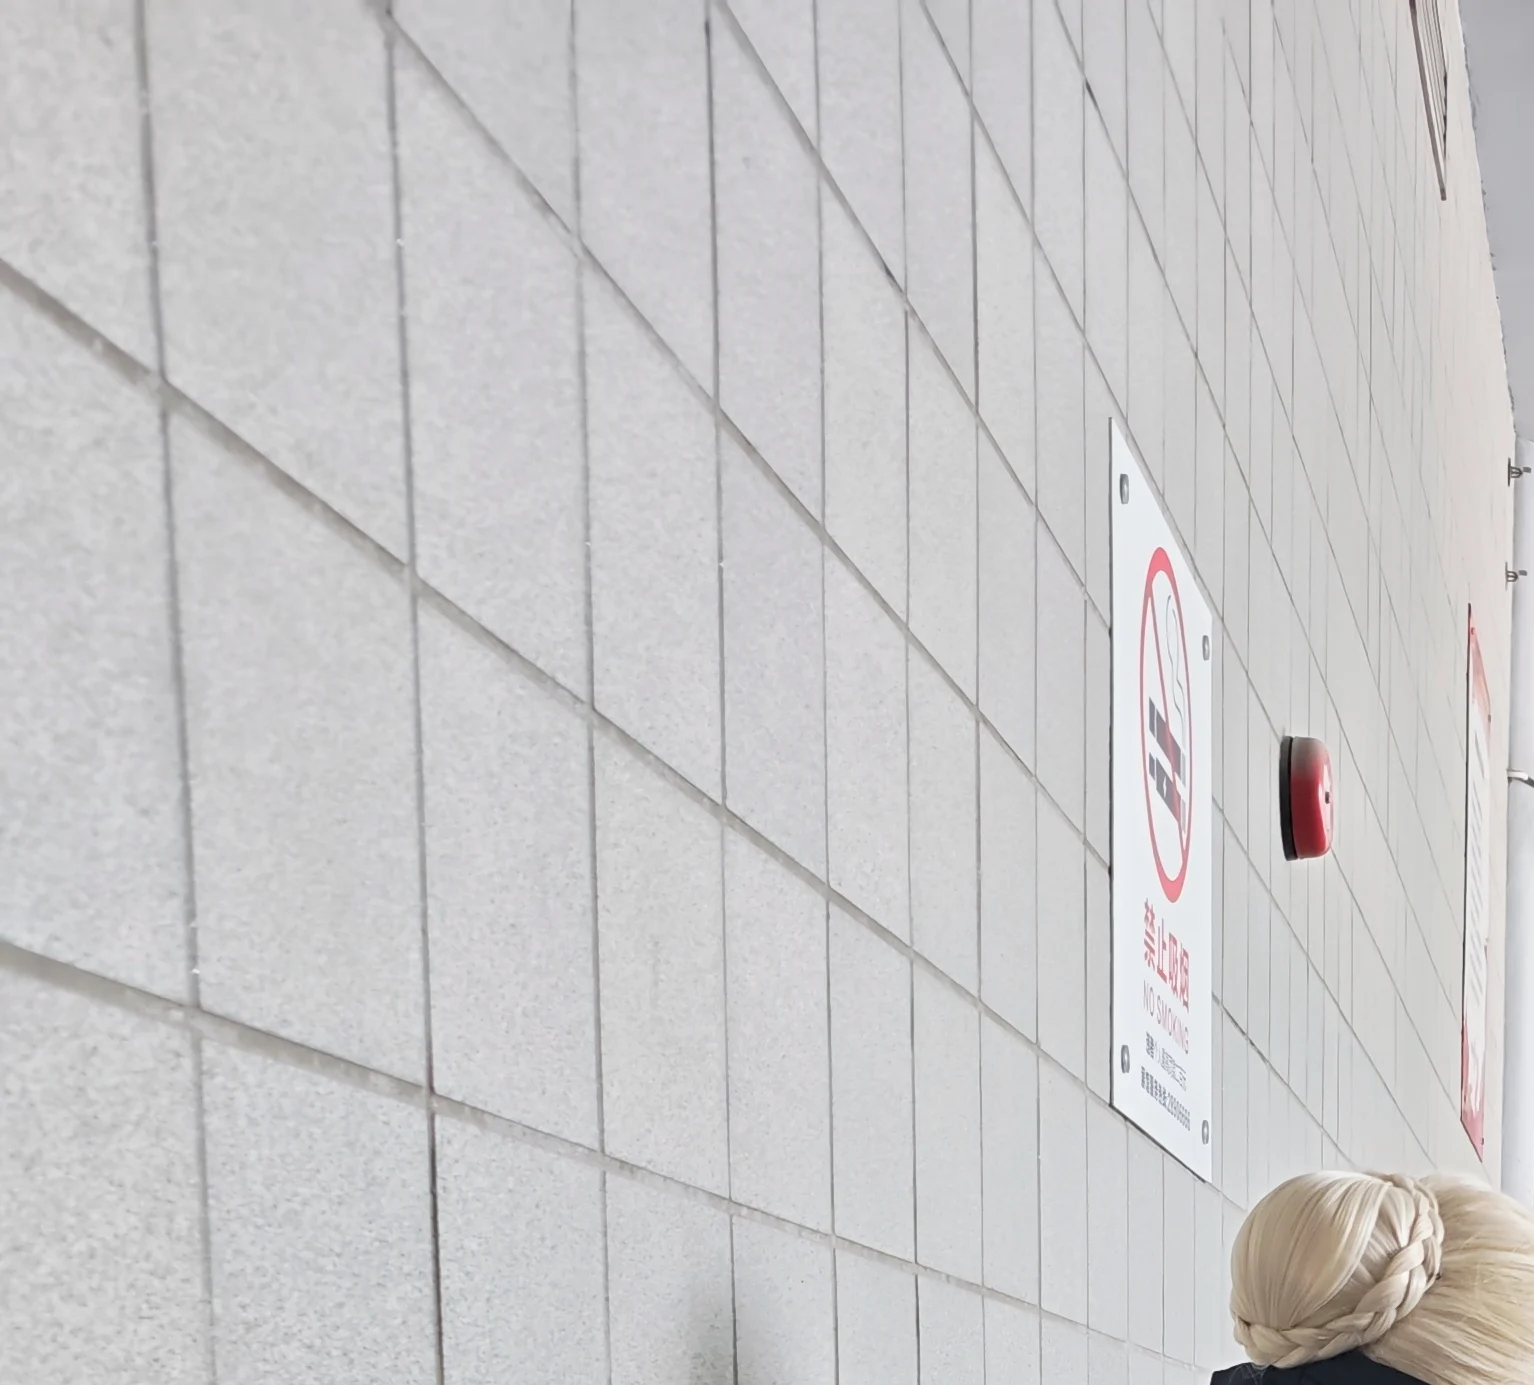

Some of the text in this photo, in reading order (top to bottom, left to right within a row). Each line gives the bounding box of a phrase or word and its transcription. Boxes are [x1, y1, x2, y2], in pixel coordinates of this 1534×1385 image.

[1143, 897, 1190, 1013] 禁止吸烟
[1143, 979, 1155, 1017] NO
[1157, 994, 1189, 1055] SMOKING
